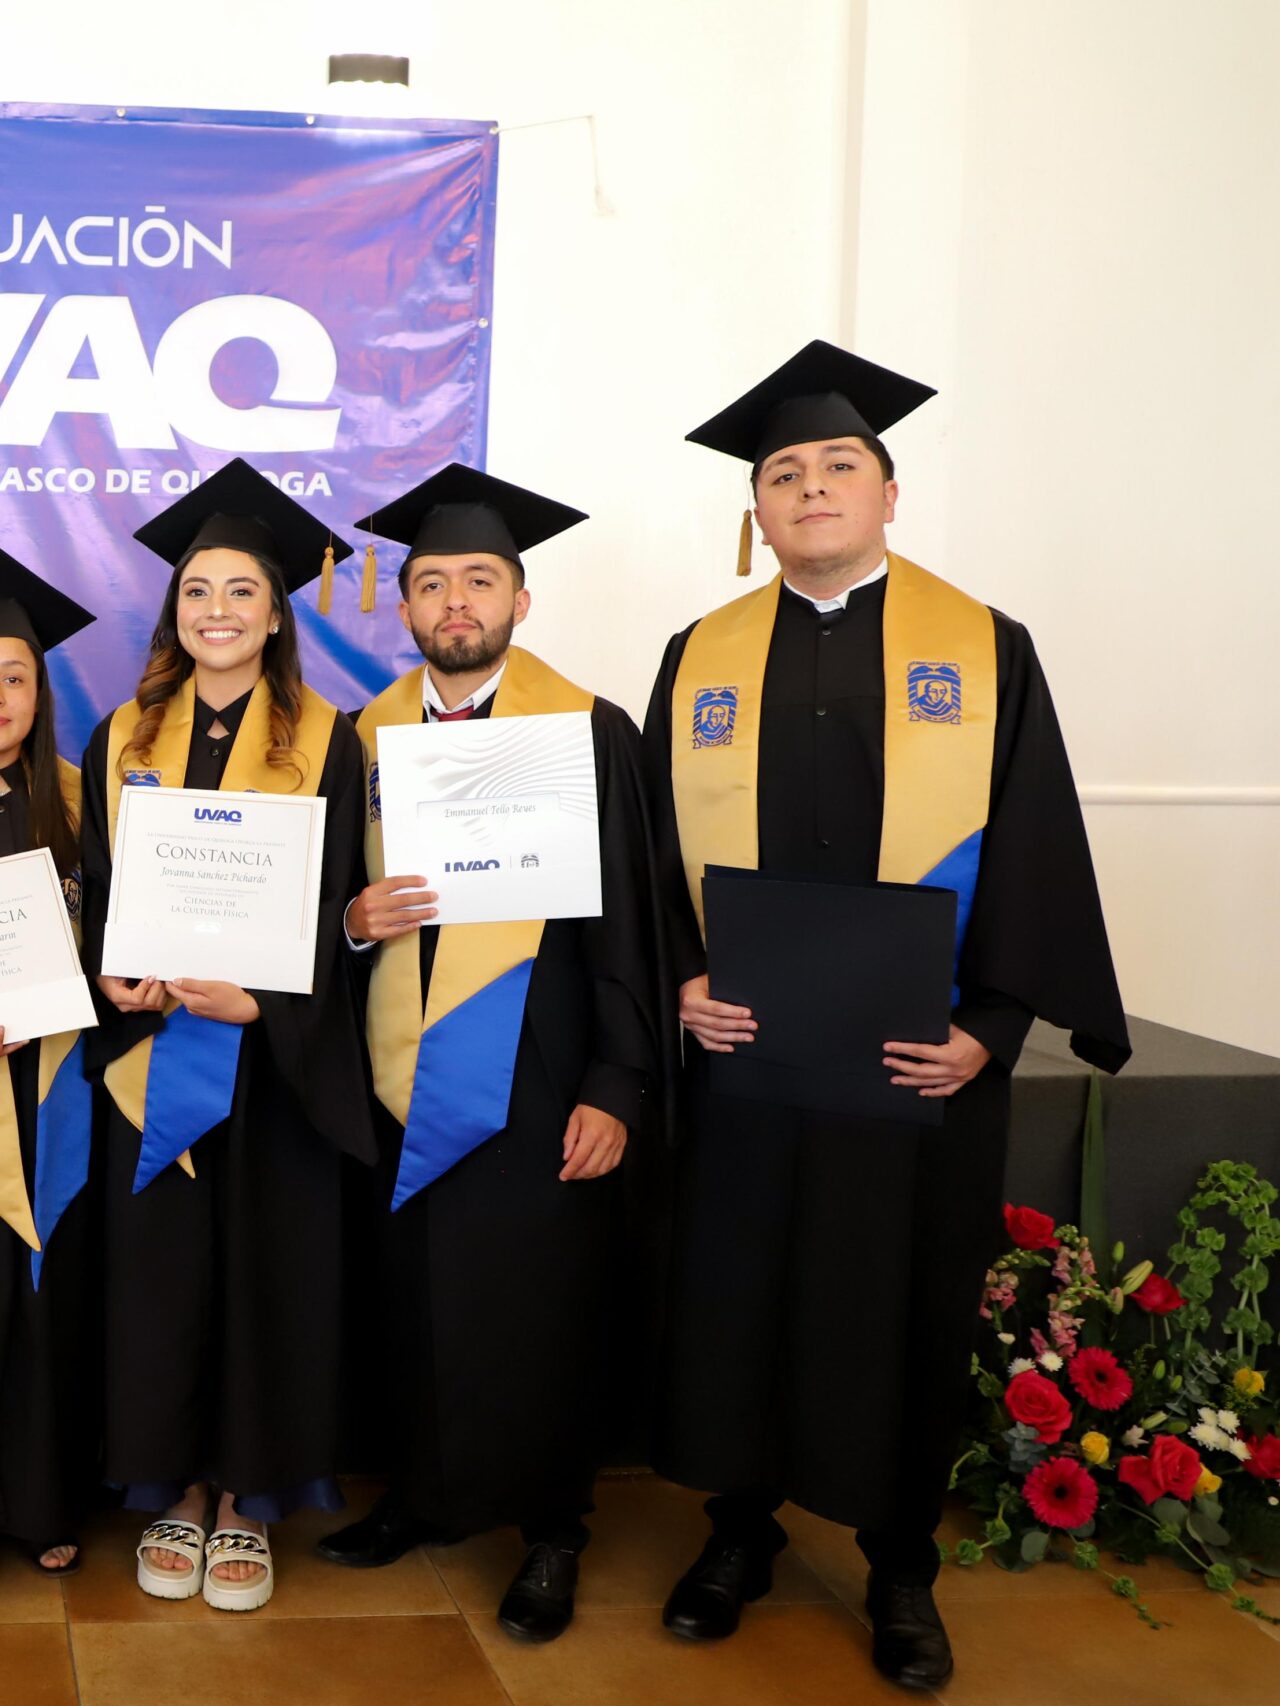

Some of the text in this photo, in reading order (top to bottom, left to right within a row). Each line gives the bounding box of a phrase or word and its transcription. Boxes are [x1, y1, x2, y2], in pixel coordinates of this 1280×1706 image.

[104, 468, 152, 494] DE
[193, 807, 243, 823] UVAQ
[444, 804, 489, 818] Emmanuel
[490, 803, 510, 815] Tello
[156, 842, 274, 868] CONSTANCIA
[160, 865, 195, 879] Jovanna
[230, 871, 268, 885] Pichardo
